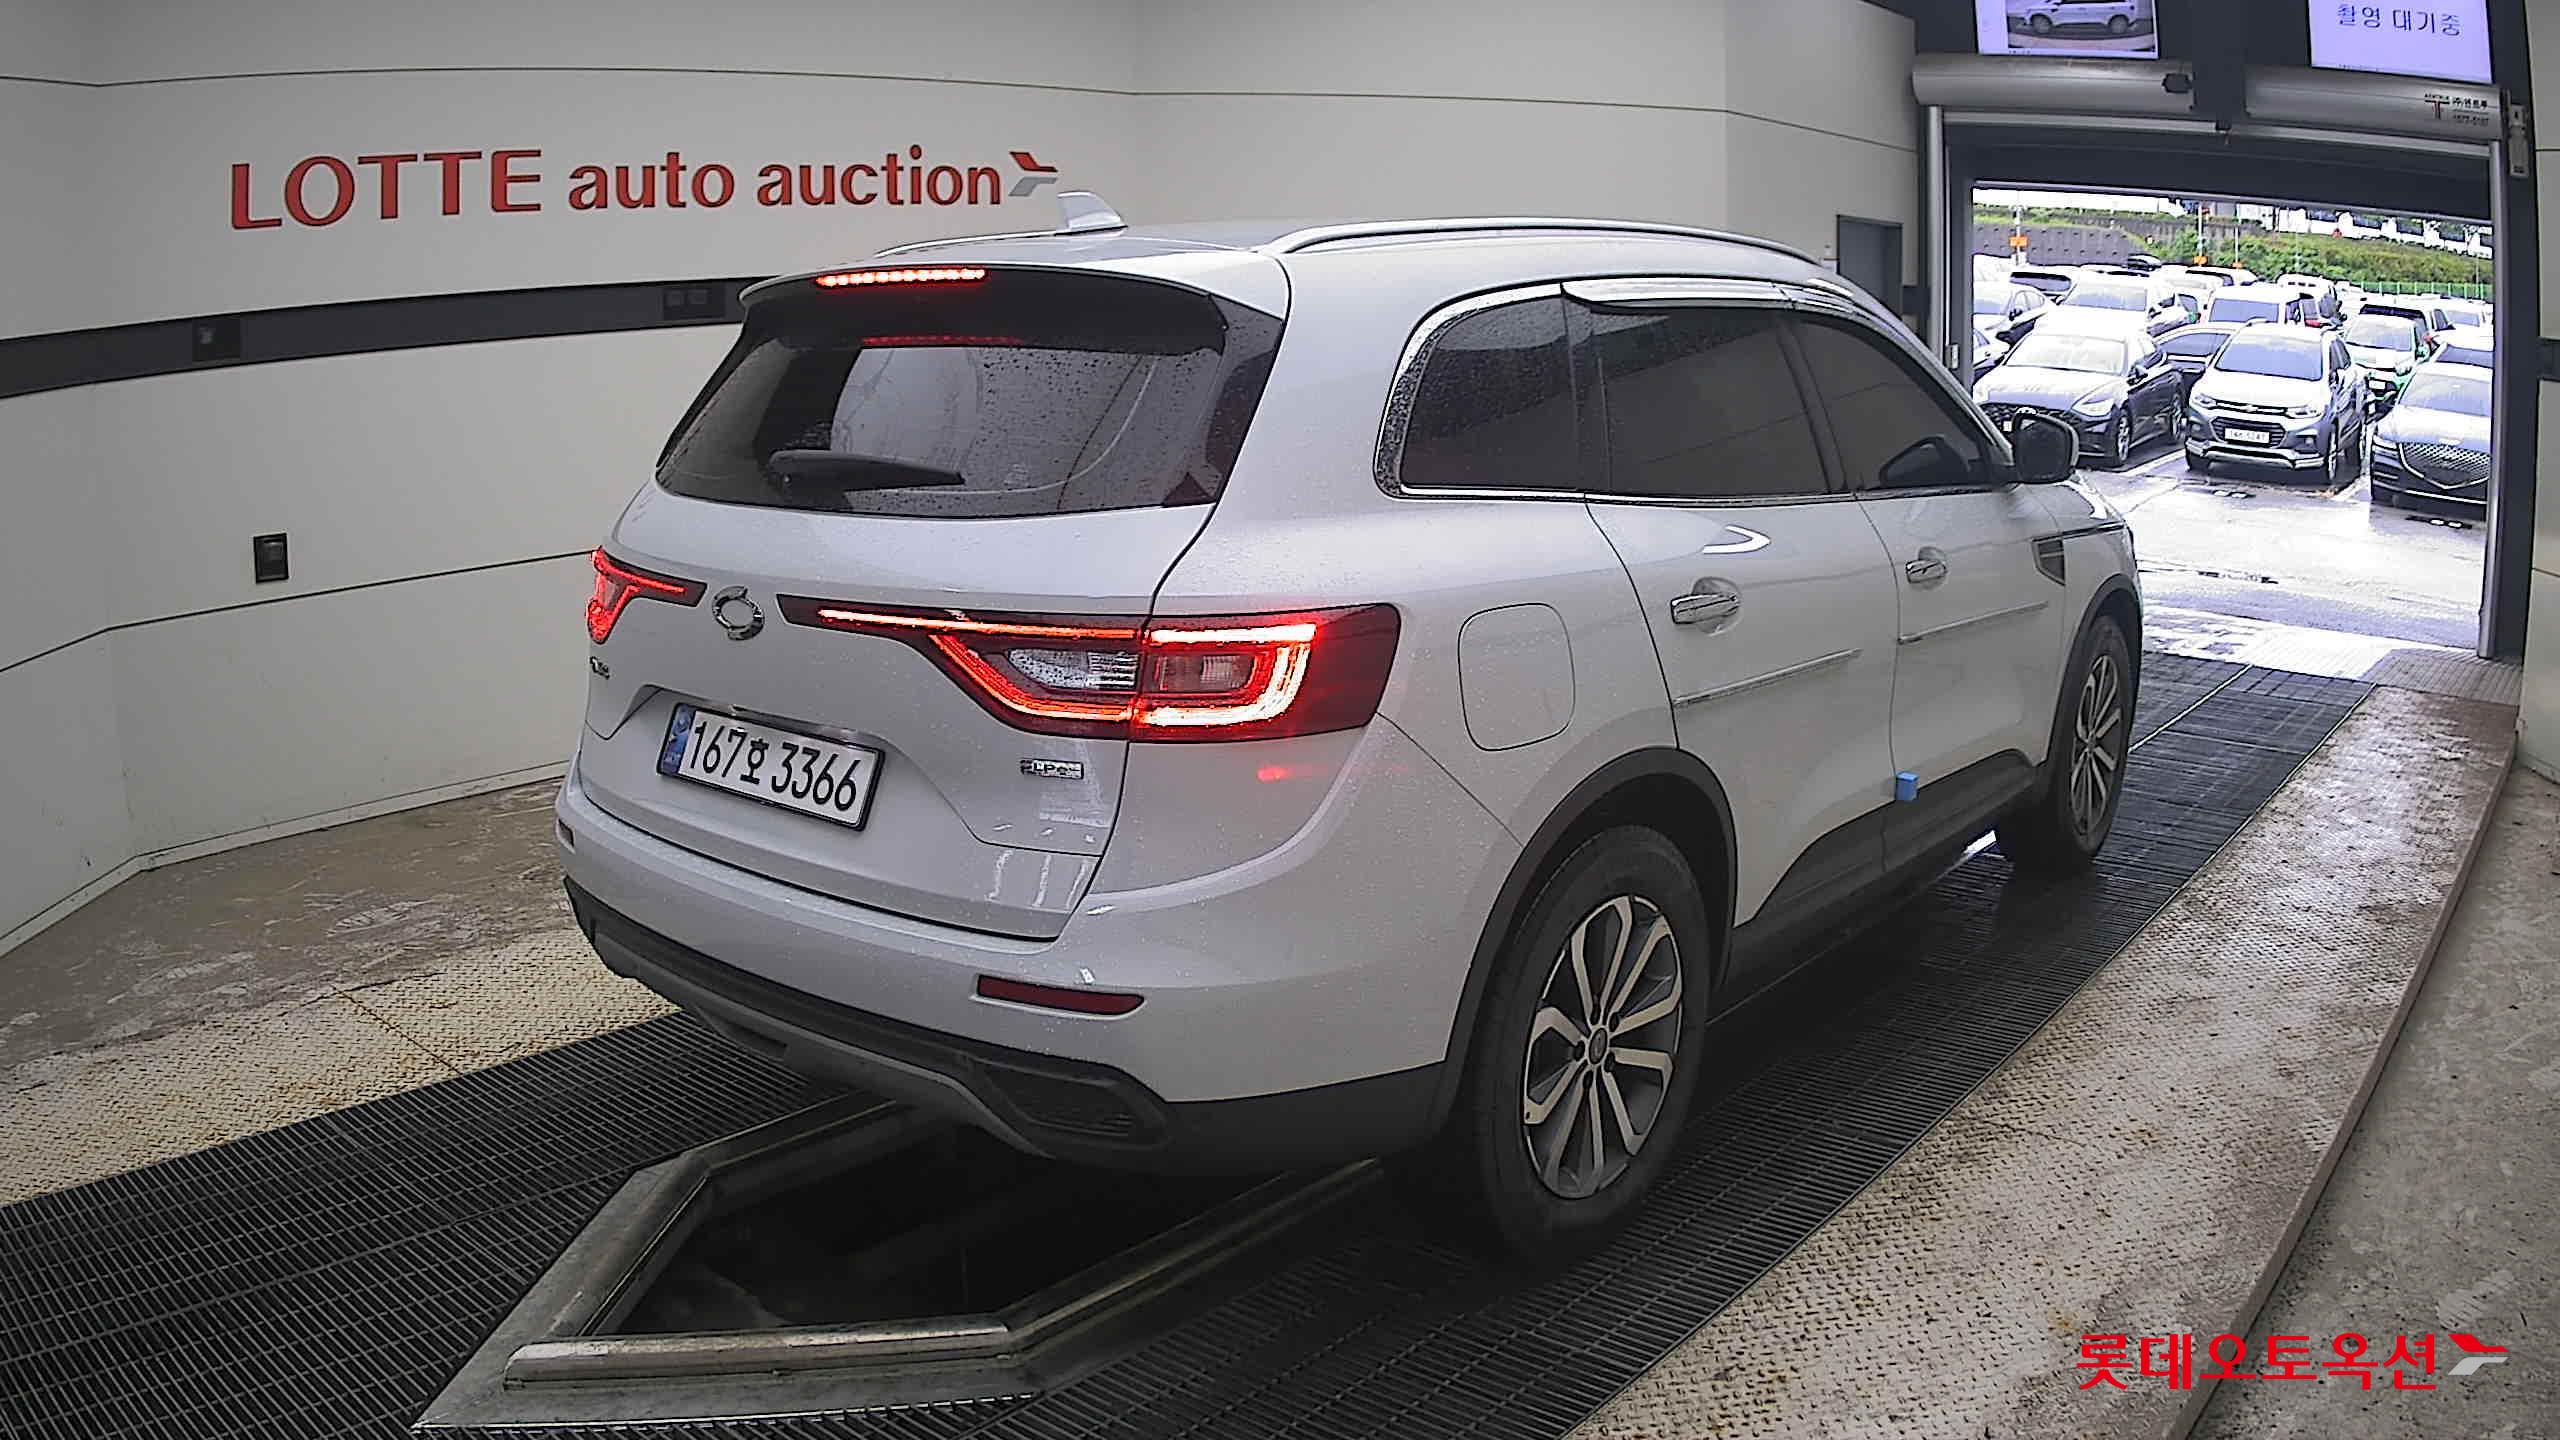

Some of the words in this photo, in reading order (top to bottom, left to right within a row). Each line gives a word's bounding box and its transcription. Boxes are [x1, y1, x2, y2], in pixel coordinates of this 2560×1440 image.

[2337, 4, 2381, 28] 촬영
[2392, 9, 2461, 37] 대기중
[230, 148, 543, 231] LOTTE
[567, 151, 735, 210] auto
[756, 143, 1002, 207] auction
[690, 721, 770, 785] 167호
[770, 741, 862, 812] 3366
